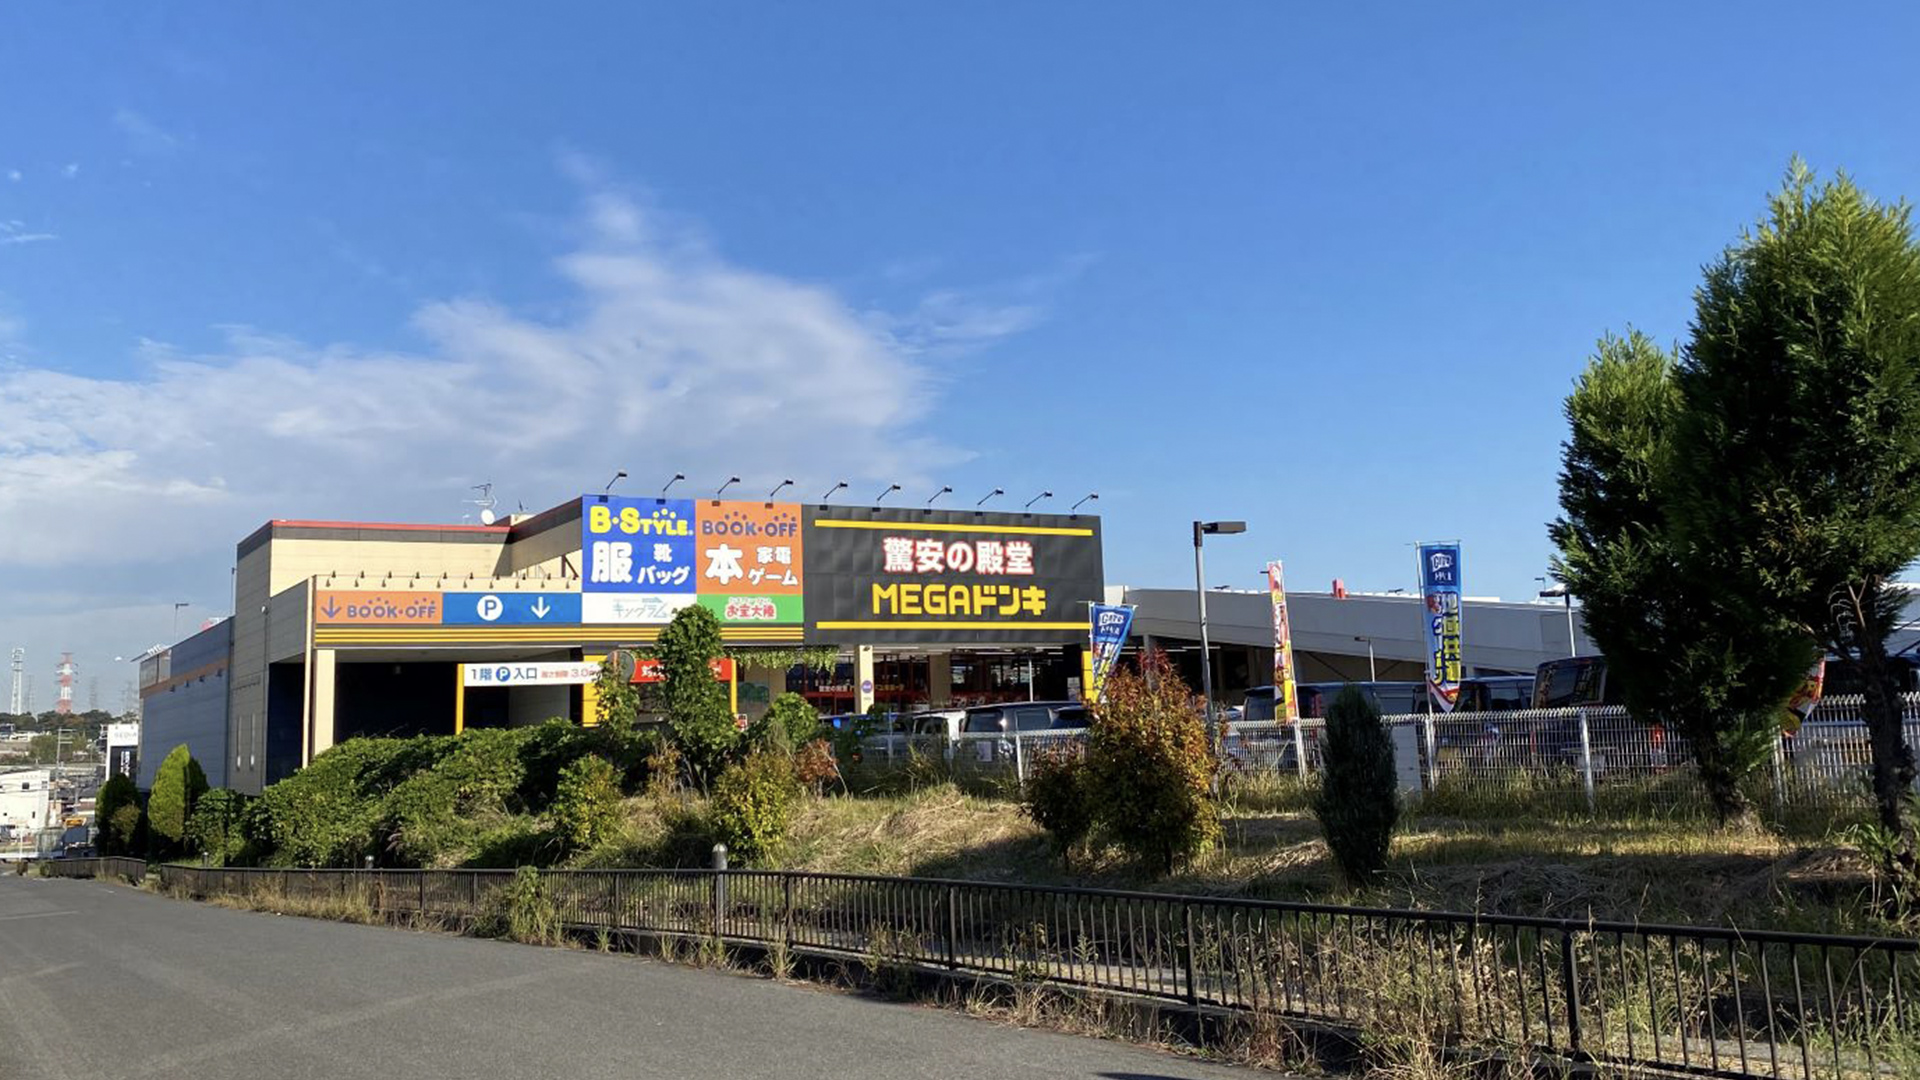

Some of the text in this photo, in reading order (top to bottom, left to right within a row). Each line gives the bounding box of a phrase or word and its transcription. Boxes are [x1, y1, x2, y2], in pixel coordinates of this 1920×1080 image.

[591, 541, 633, 583] 服
[705, 543, 744, 586] 本
[756, 546, 792, 565] 家電
[883, 536, 1035, 575] 驚安の殿堂
[636, 565, 691, 586] バッグ
[747, 567, 799, 586] ゲーム
[872, 583, 1047, 616] MEGAドンキ
[471, 668, 493, 681] 1階
[513, 667, 538, 680] 入口
